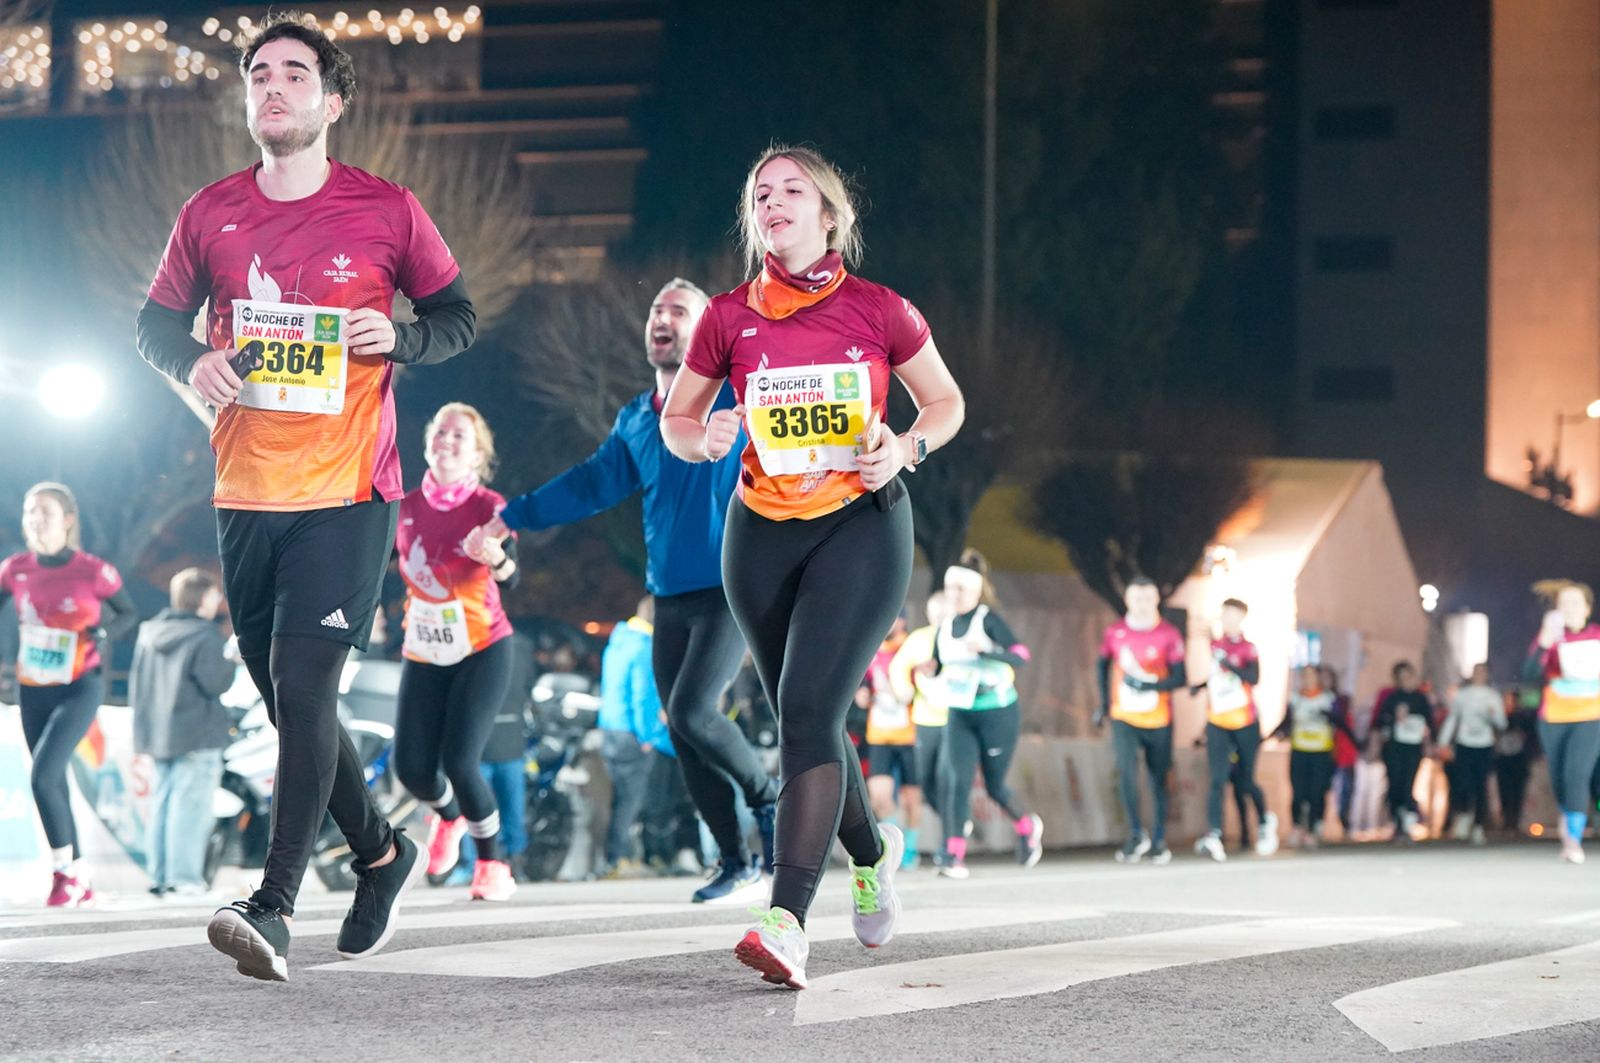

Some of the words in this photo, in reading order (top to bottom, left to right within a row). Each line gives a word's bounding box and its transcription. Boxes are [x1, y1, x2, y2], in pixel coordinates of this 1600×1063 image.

[254, 313, 289, 326] NOCHE
[290, 316, 305, 327] DE
[241, 325, 263, 338] SAN
[264, 326, 304, 341] ANTÓN
[278, 376, 306, 386] Antonio
[772, 379, 807, 391] NOCHE
[809, 378, 823, 389] DE
[759, 393, 782, 406] SAN
[785, 389, 825, 405] ANTÓN
[769, 404, 849, 438] 3365
[798, 438, 826, 448] Cristina
[320, 618, 349, 630] adidas
